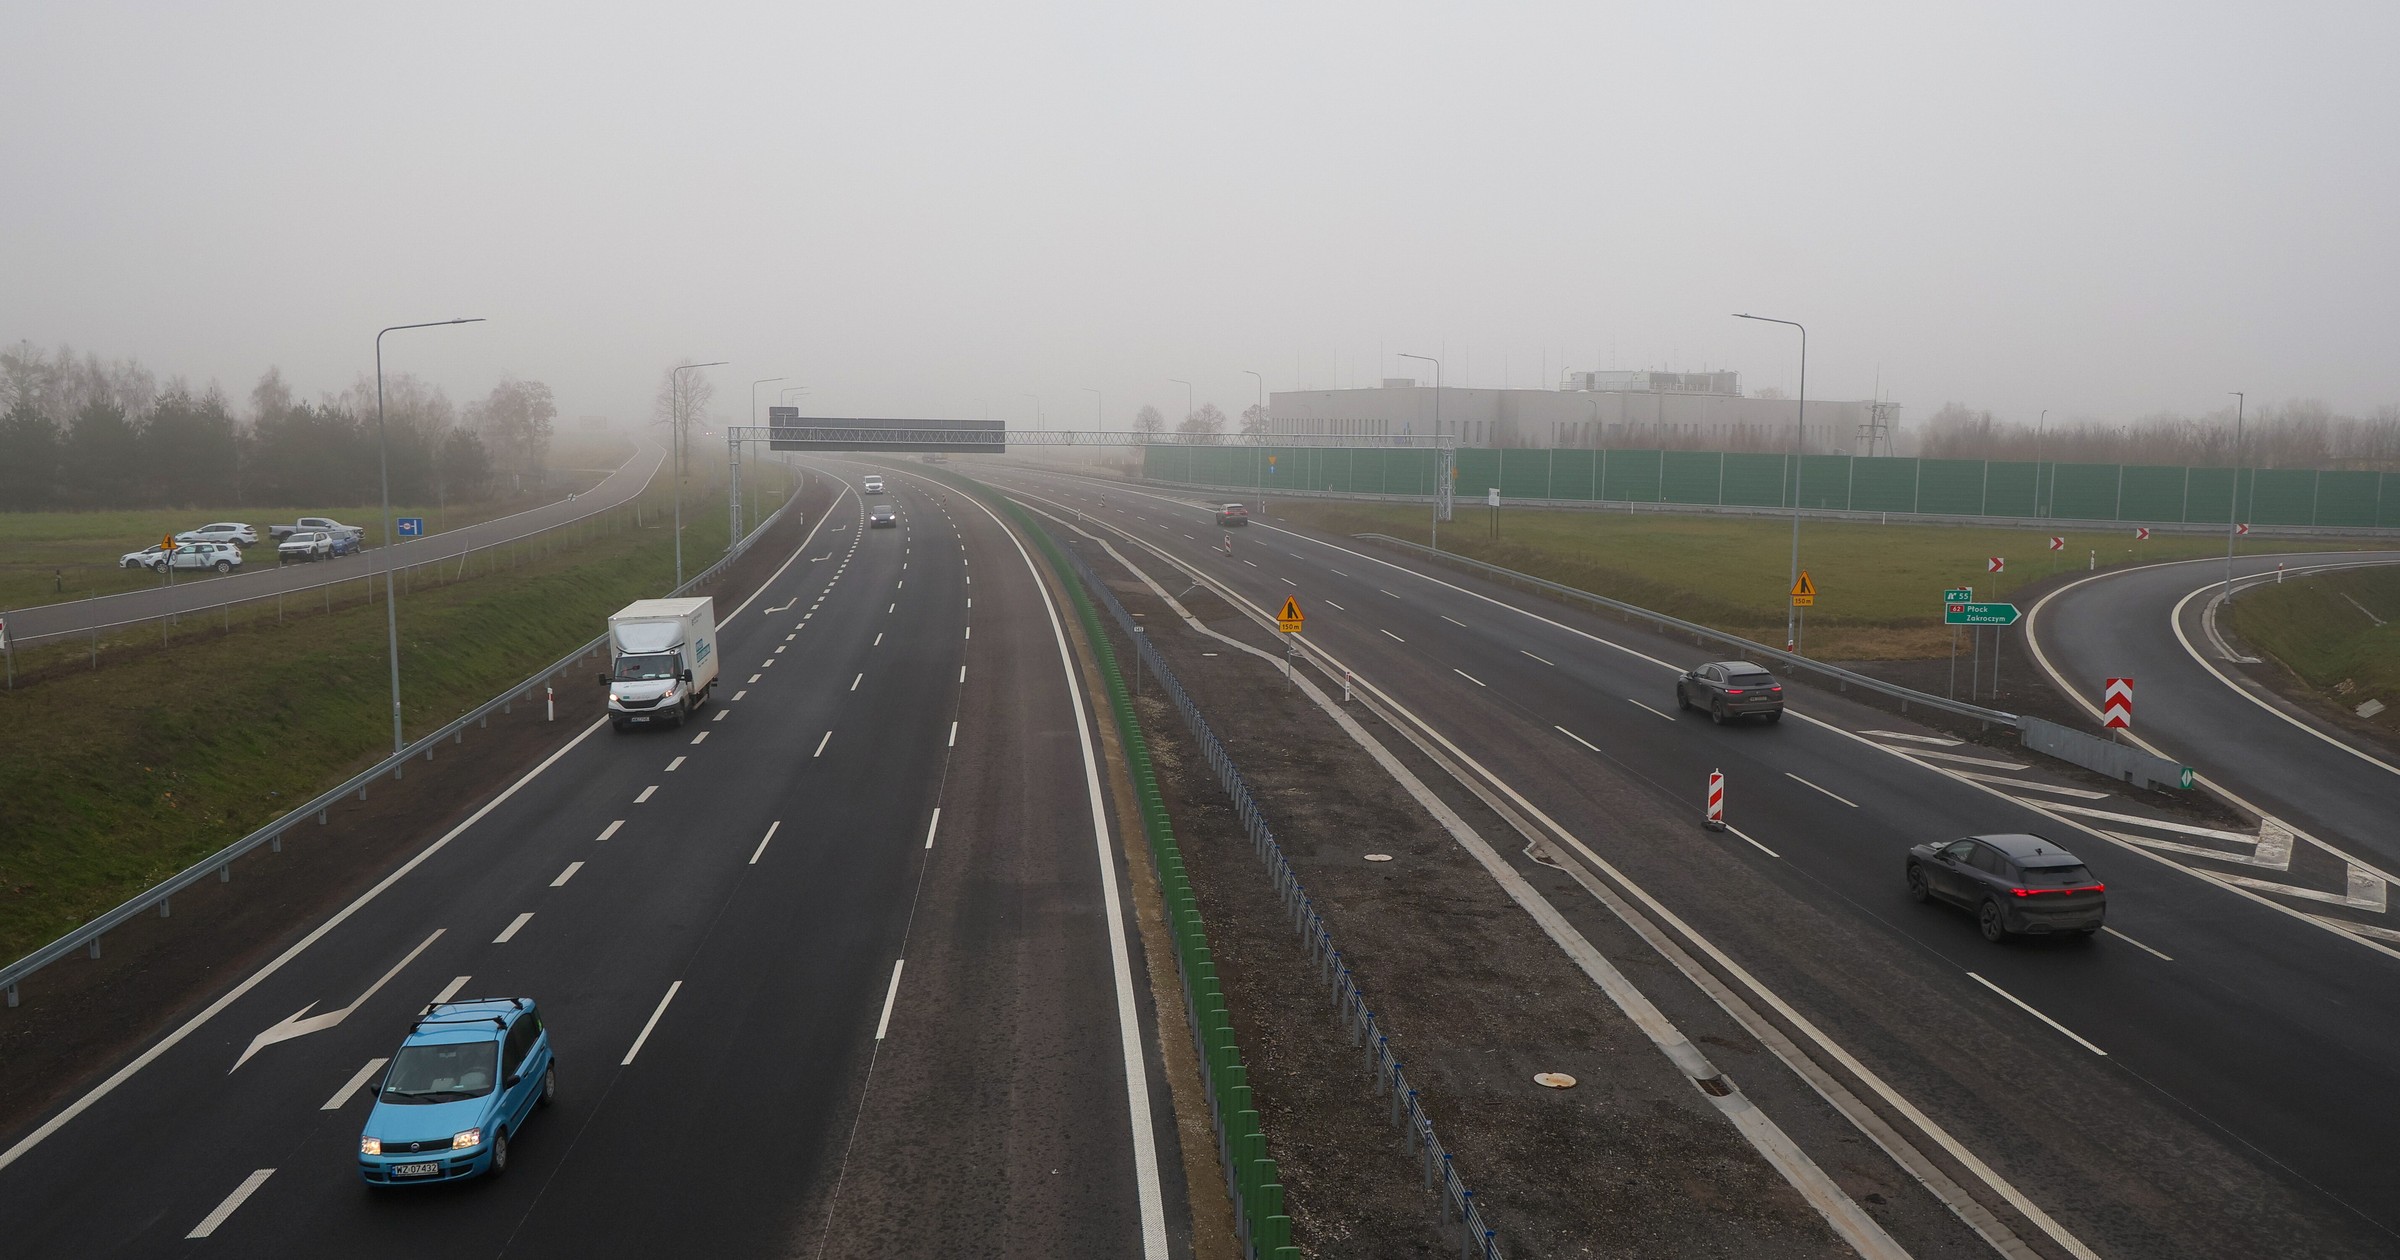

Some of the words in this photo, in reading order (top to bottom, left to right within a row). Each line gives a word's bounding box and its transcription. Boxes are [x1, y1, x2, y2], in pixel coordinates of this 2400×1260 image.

[1966, 615, 2006, 623] Zakroczym
[396, 1165, 408, 1174] WZ
[410, 1164, 437, 1173] 07432
